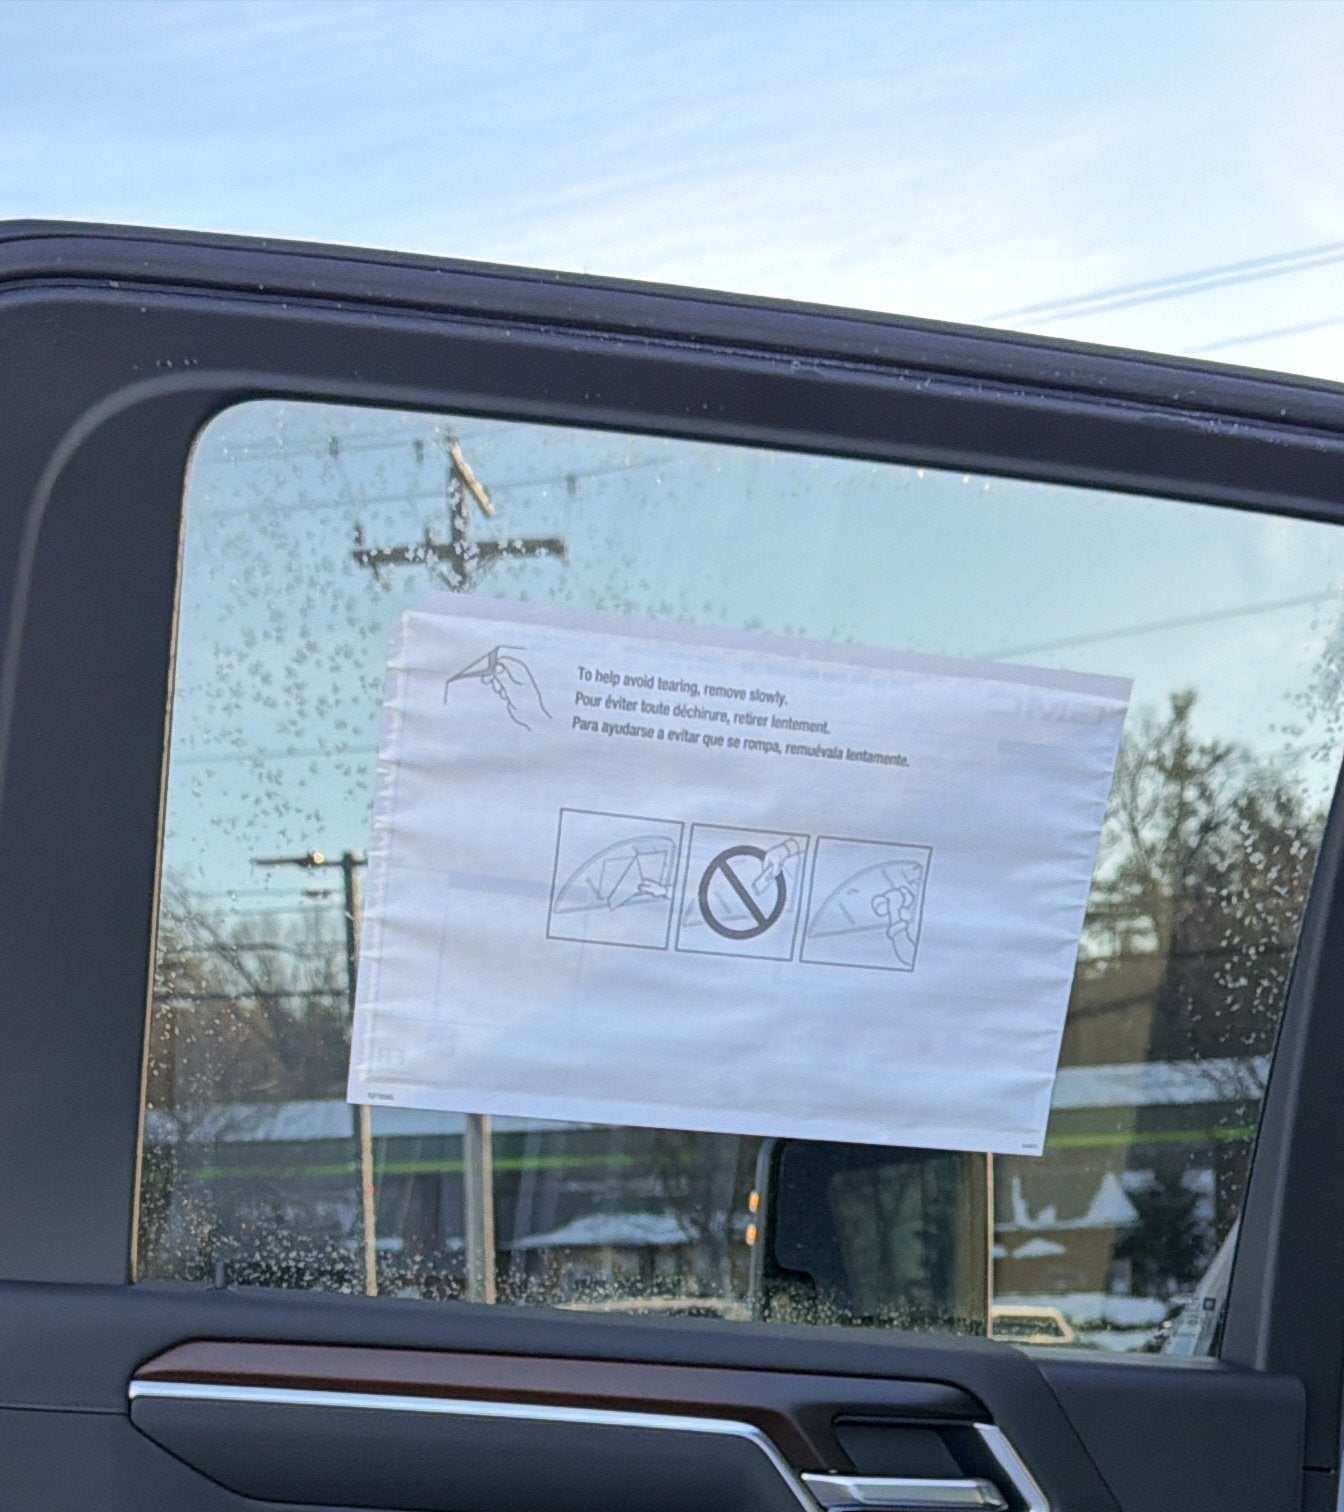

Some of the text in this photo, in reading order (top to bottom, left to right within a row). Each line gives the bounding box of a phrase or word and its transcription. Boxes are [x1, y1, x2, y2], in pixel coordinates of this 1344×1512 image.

[578, 666, 788, 708] To help avoid tearing, remove slowly.
[575, 691, 830, 734] Pour éviter toute déchirure, retirer lentement.
[572, 716, 910, 767] Para ayudarse a evitar que se rompa, remuévala lentamente.
